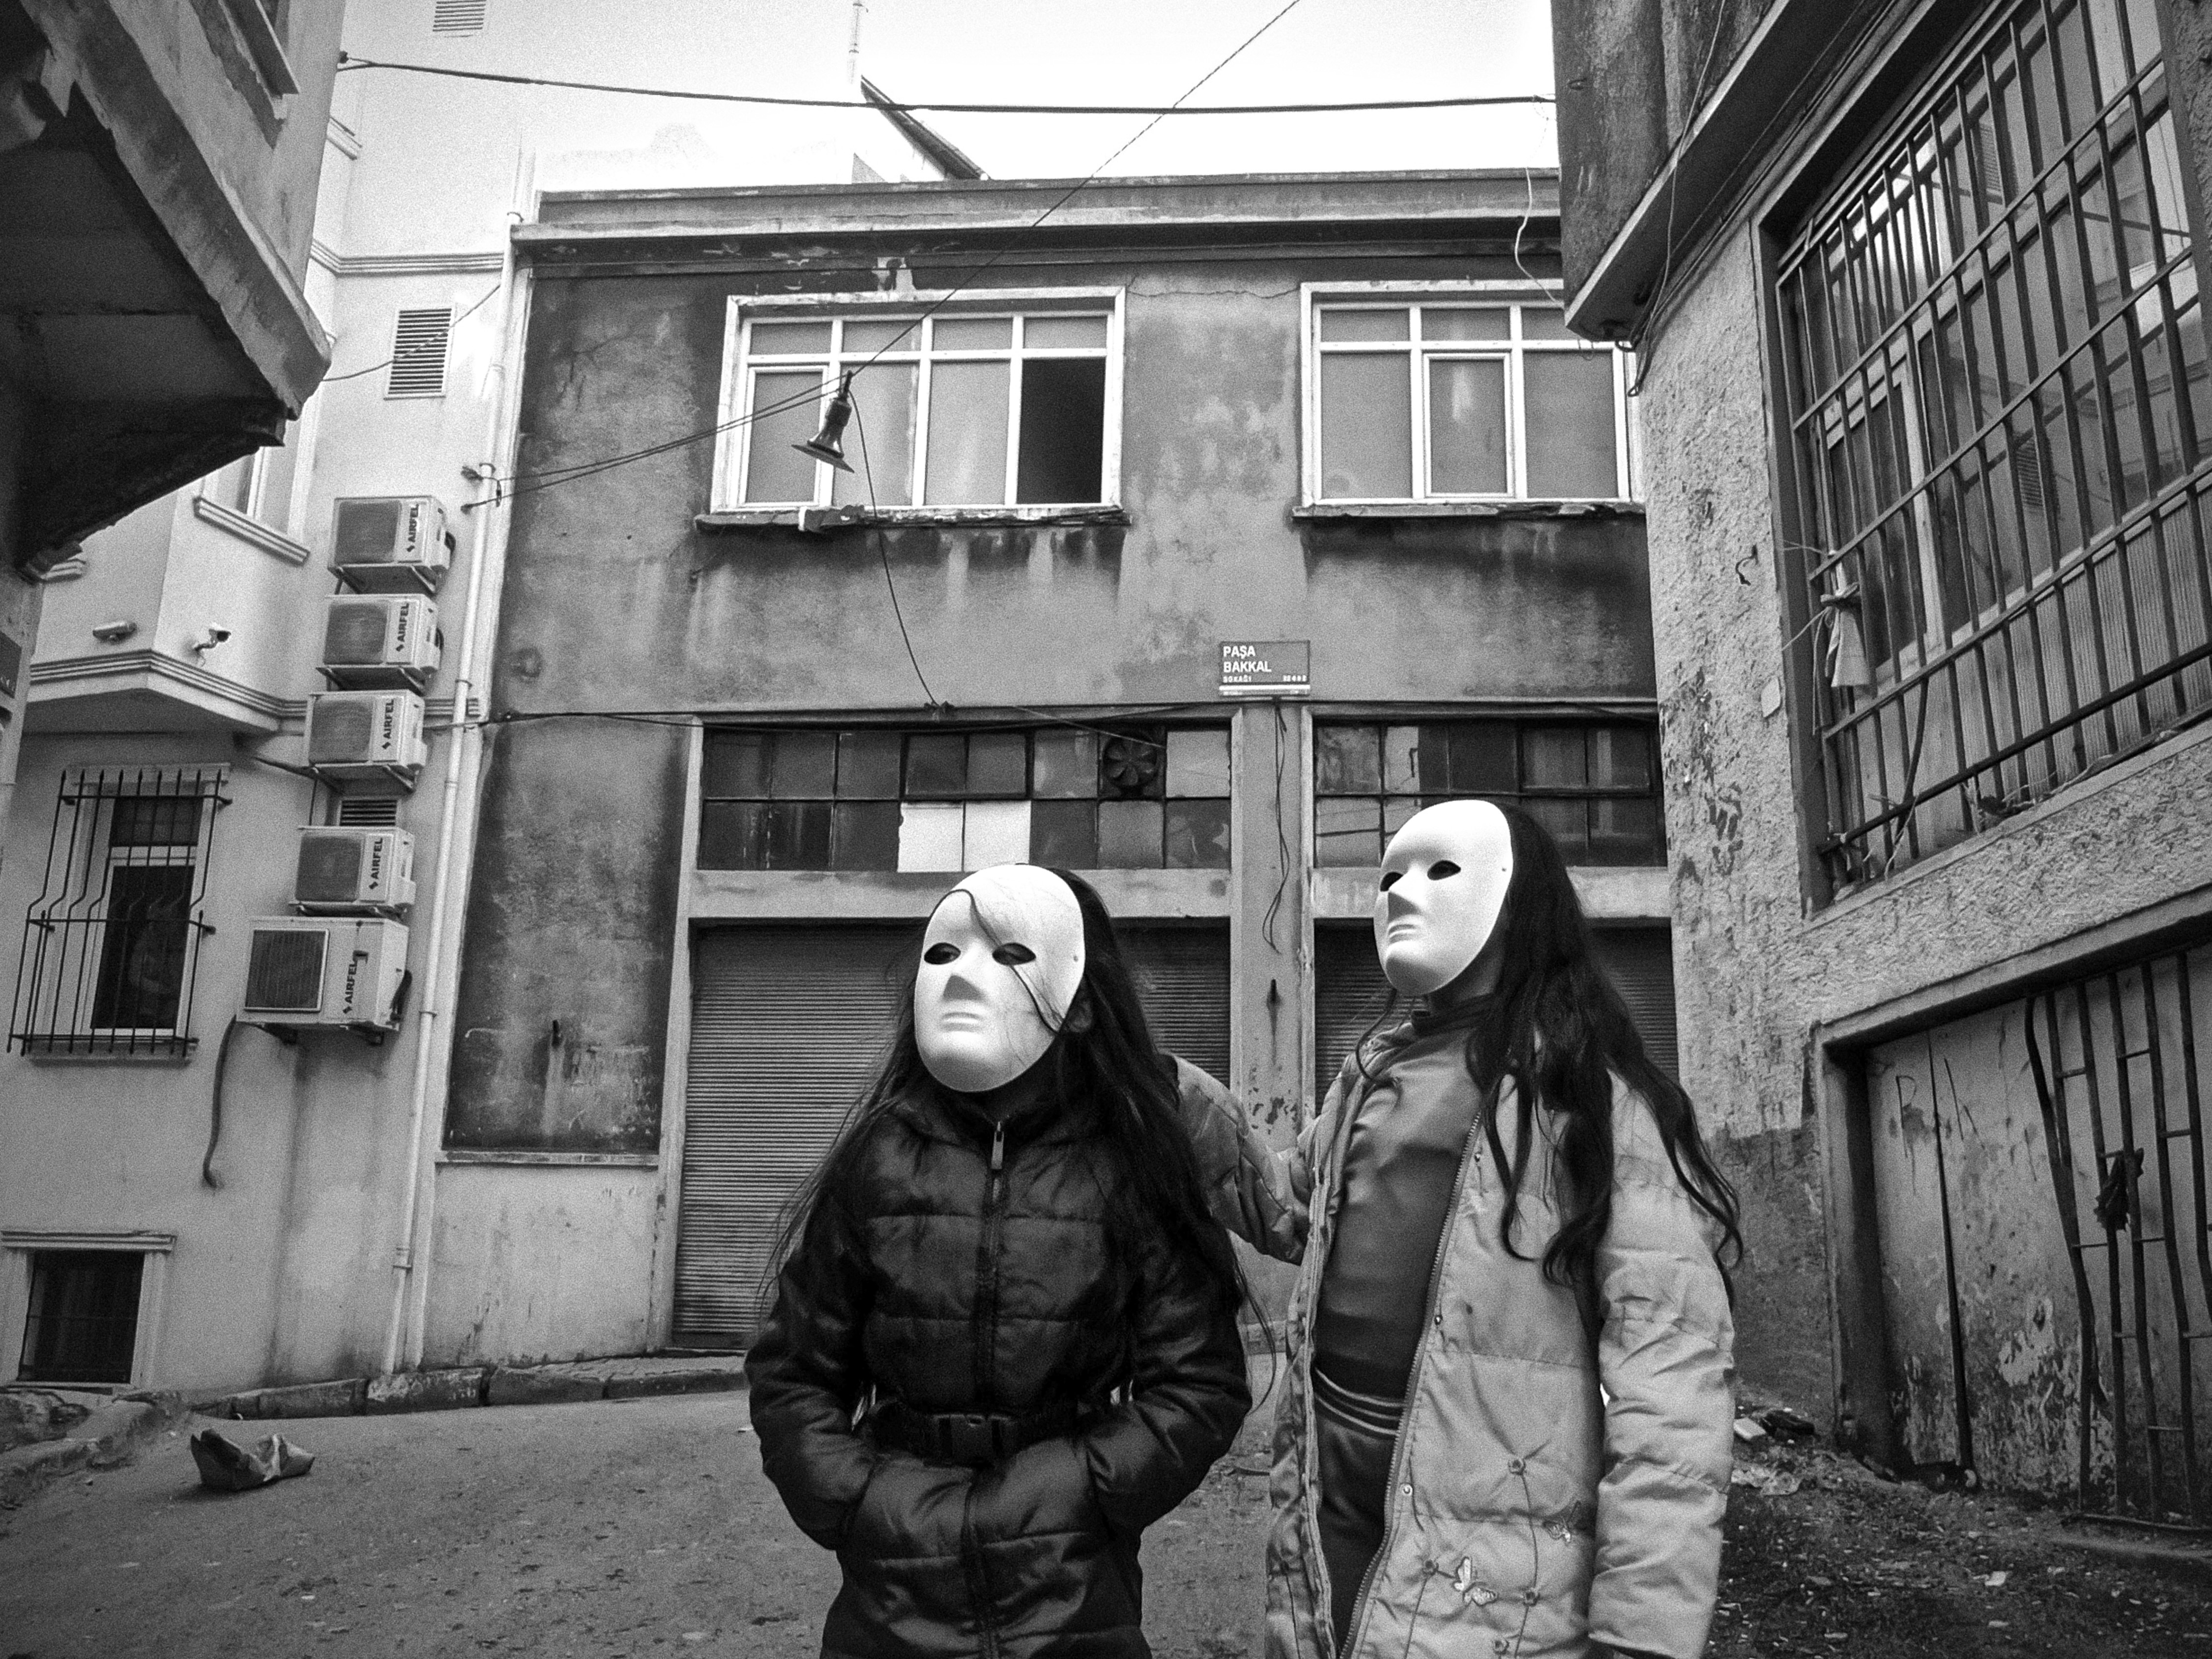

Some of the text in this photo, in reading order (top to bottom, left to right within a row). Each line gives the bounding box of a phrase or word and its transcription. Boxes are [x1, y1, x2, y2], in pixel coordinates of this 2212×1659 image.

[407, 503, 419, 543] AIRFEL
[397, 603, 409, 642] AIRFEL
[1223, 645, 1256, 659] PAŞA
[1223, 661, 1272, 673] BAKKAL
[383, 699, 394, 739] AIRFEL
[371, 838, 382, 879] AIRFEL
[345, 960, 357, 1003] AIRFEL
